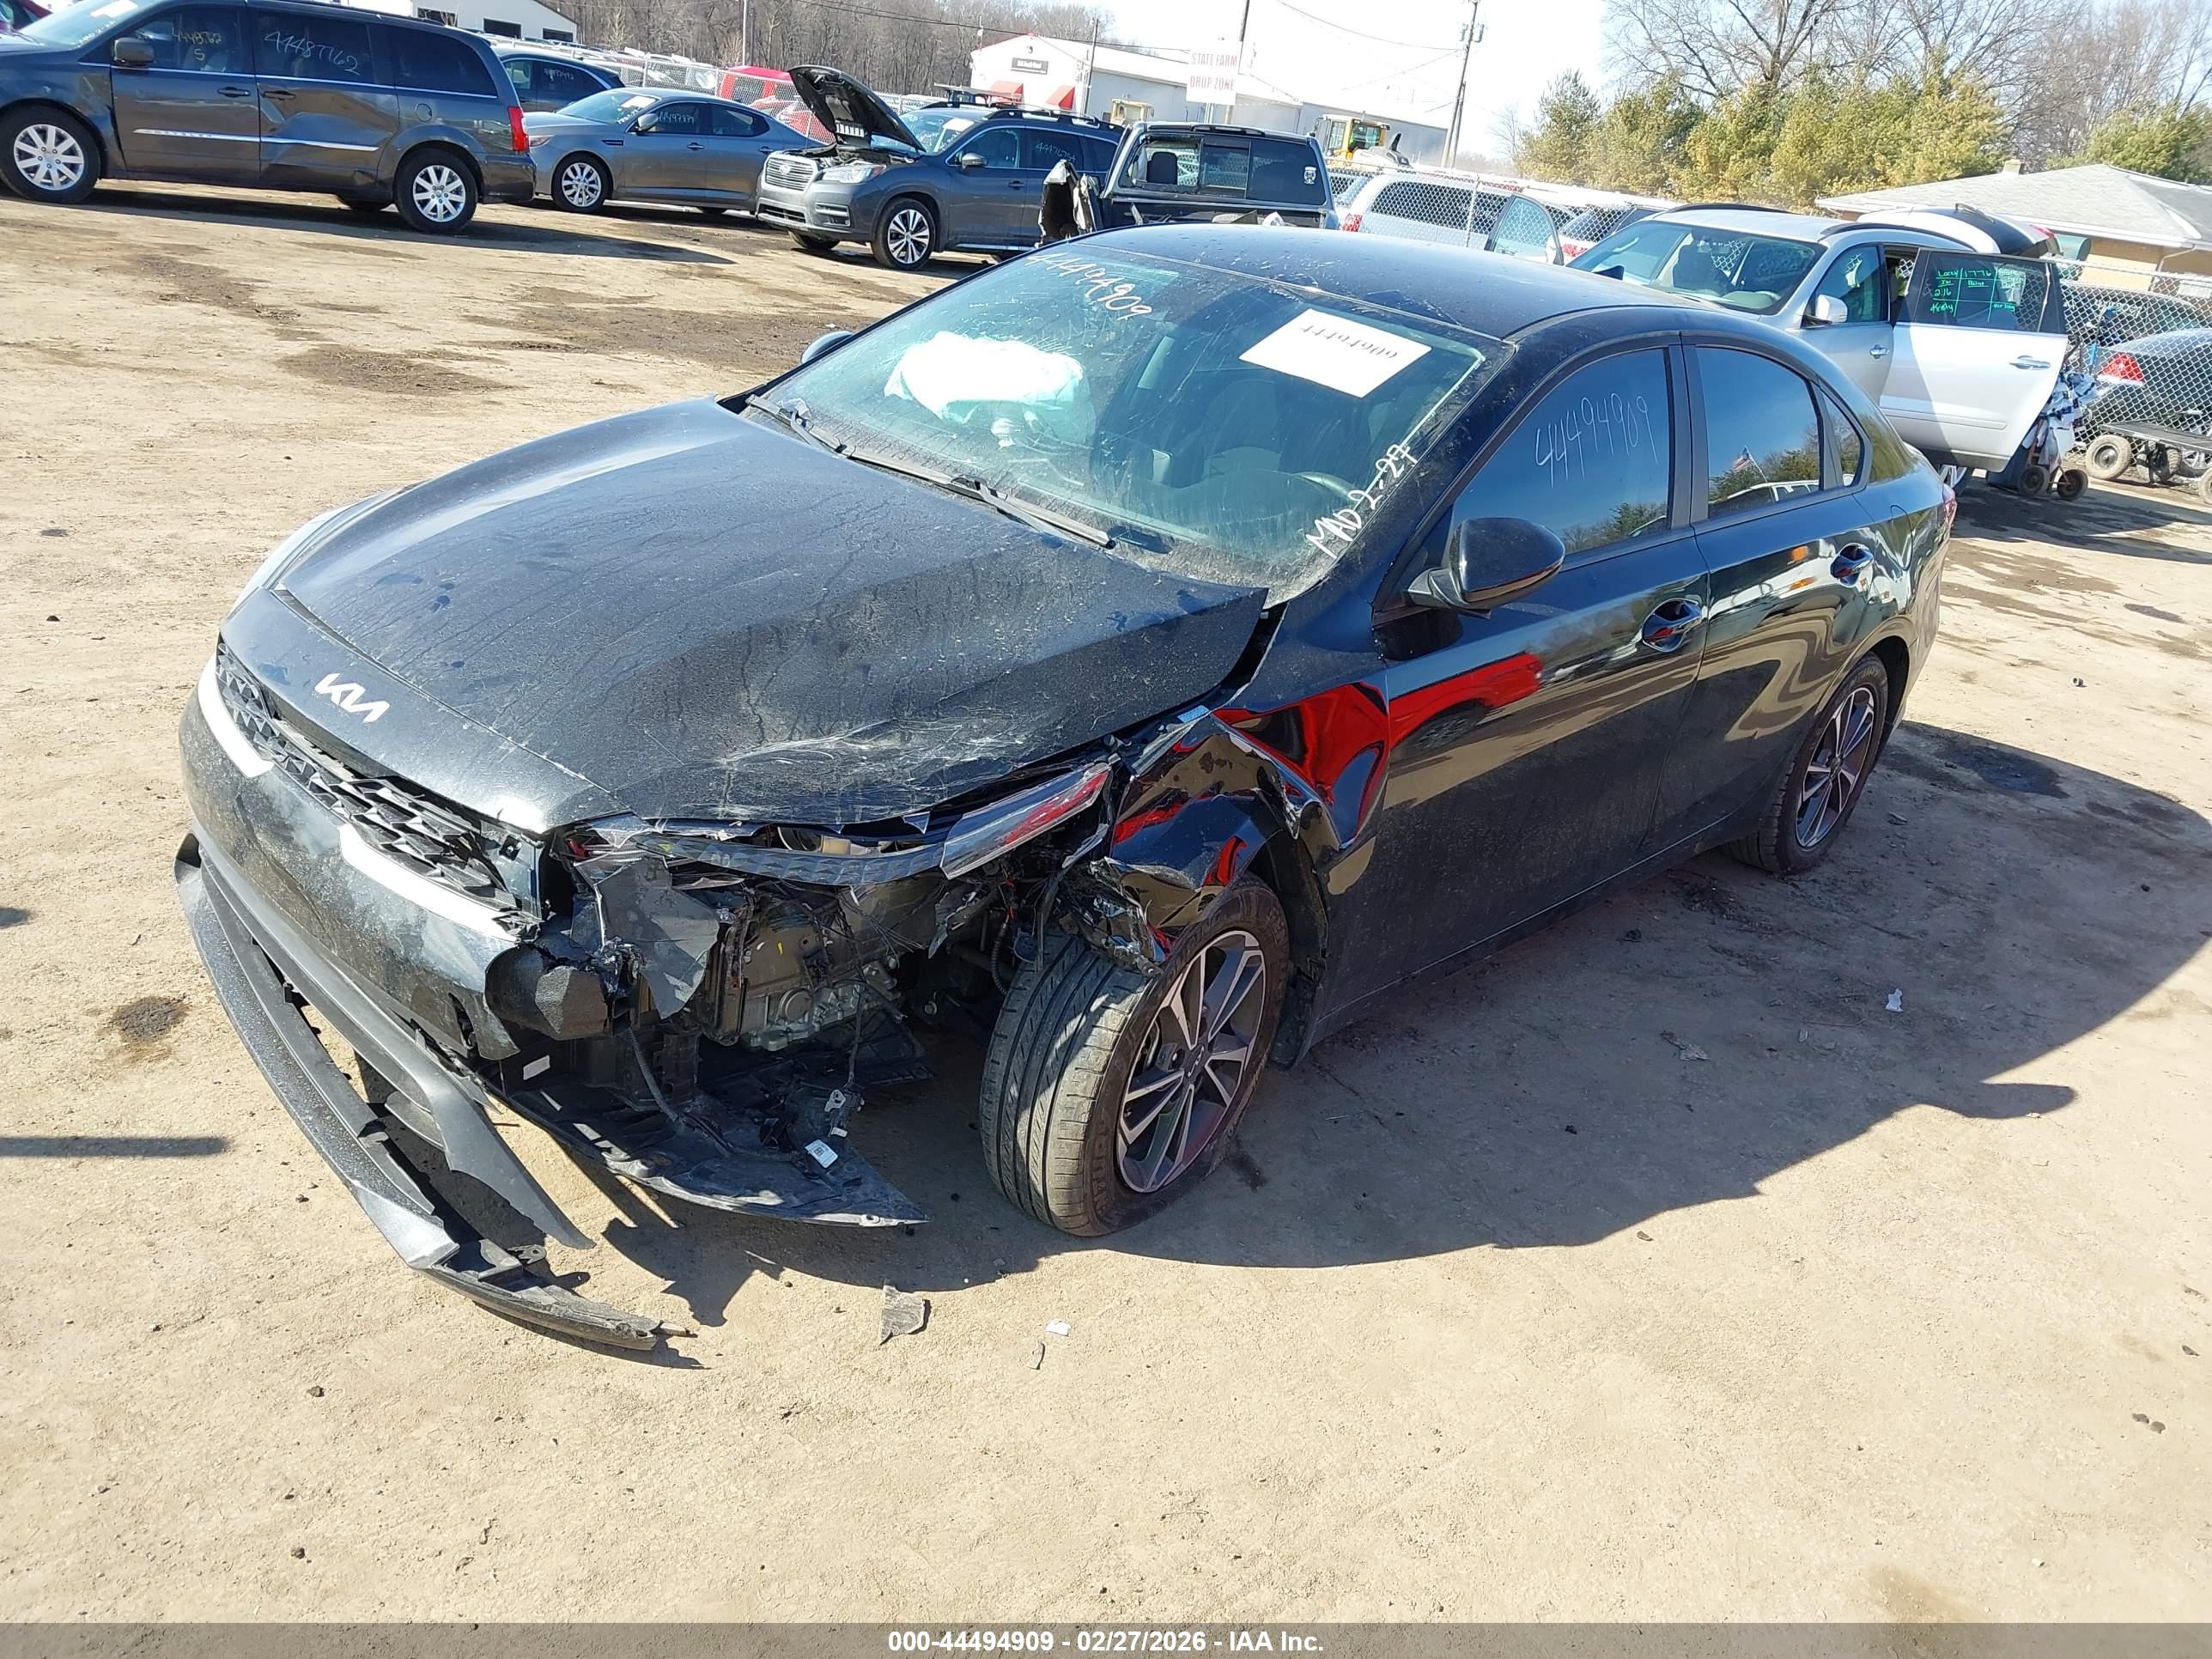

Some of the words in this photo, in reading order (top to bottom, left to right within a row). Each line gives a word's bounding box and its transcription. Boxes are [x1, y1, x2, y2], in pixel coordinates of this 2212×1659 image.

[1189, 75, 1212, 89] DROP
[1214, 77, 1235, 91] ZONE
[1191, 52, 1214, 66] STATE
[1216, 54, 1237, 68] FARM
[1024, 252, 1152, 321] 44494909
[1535, 392, 1658, 489] 44494909
[1305, 508, 1362, 559] MAD
